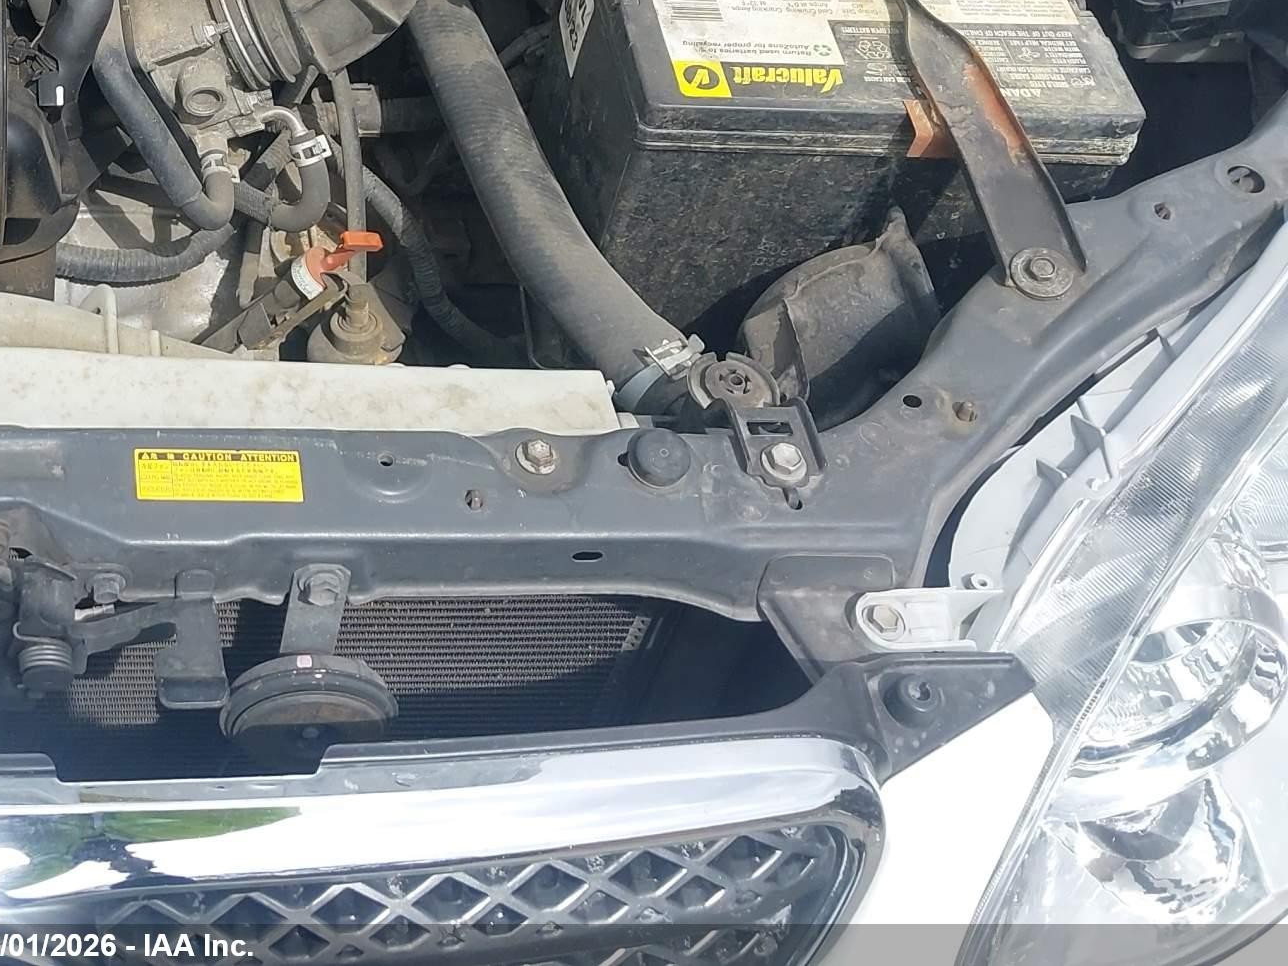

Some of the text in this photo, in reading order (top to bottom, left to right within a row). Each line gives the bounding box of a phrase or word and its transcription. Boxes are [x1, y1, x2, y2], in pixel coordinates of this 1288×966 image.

[994, 30, 1015, 38] REACH
[1016, 30, 1028, 38] THE
[1032, 30, 1040, 38] OF
[1042, 30, 1053, 38] OUT
[1056, 30, 1072, 38] KEEP
[723, 41, 751, 49] proper
[768, 42, 809, 50] AutoZone
[719, 48, 756, 56] batteries
[759, 48, 779, 56] used
[782, 49, 811, 57] Return
[729, 66, 843, 93] Valucraft
[1001, 88, 1031, 98] DAN
[183, 452, 233, 462] CAUTION
[240, 453, 298, 463] ATTENTION
